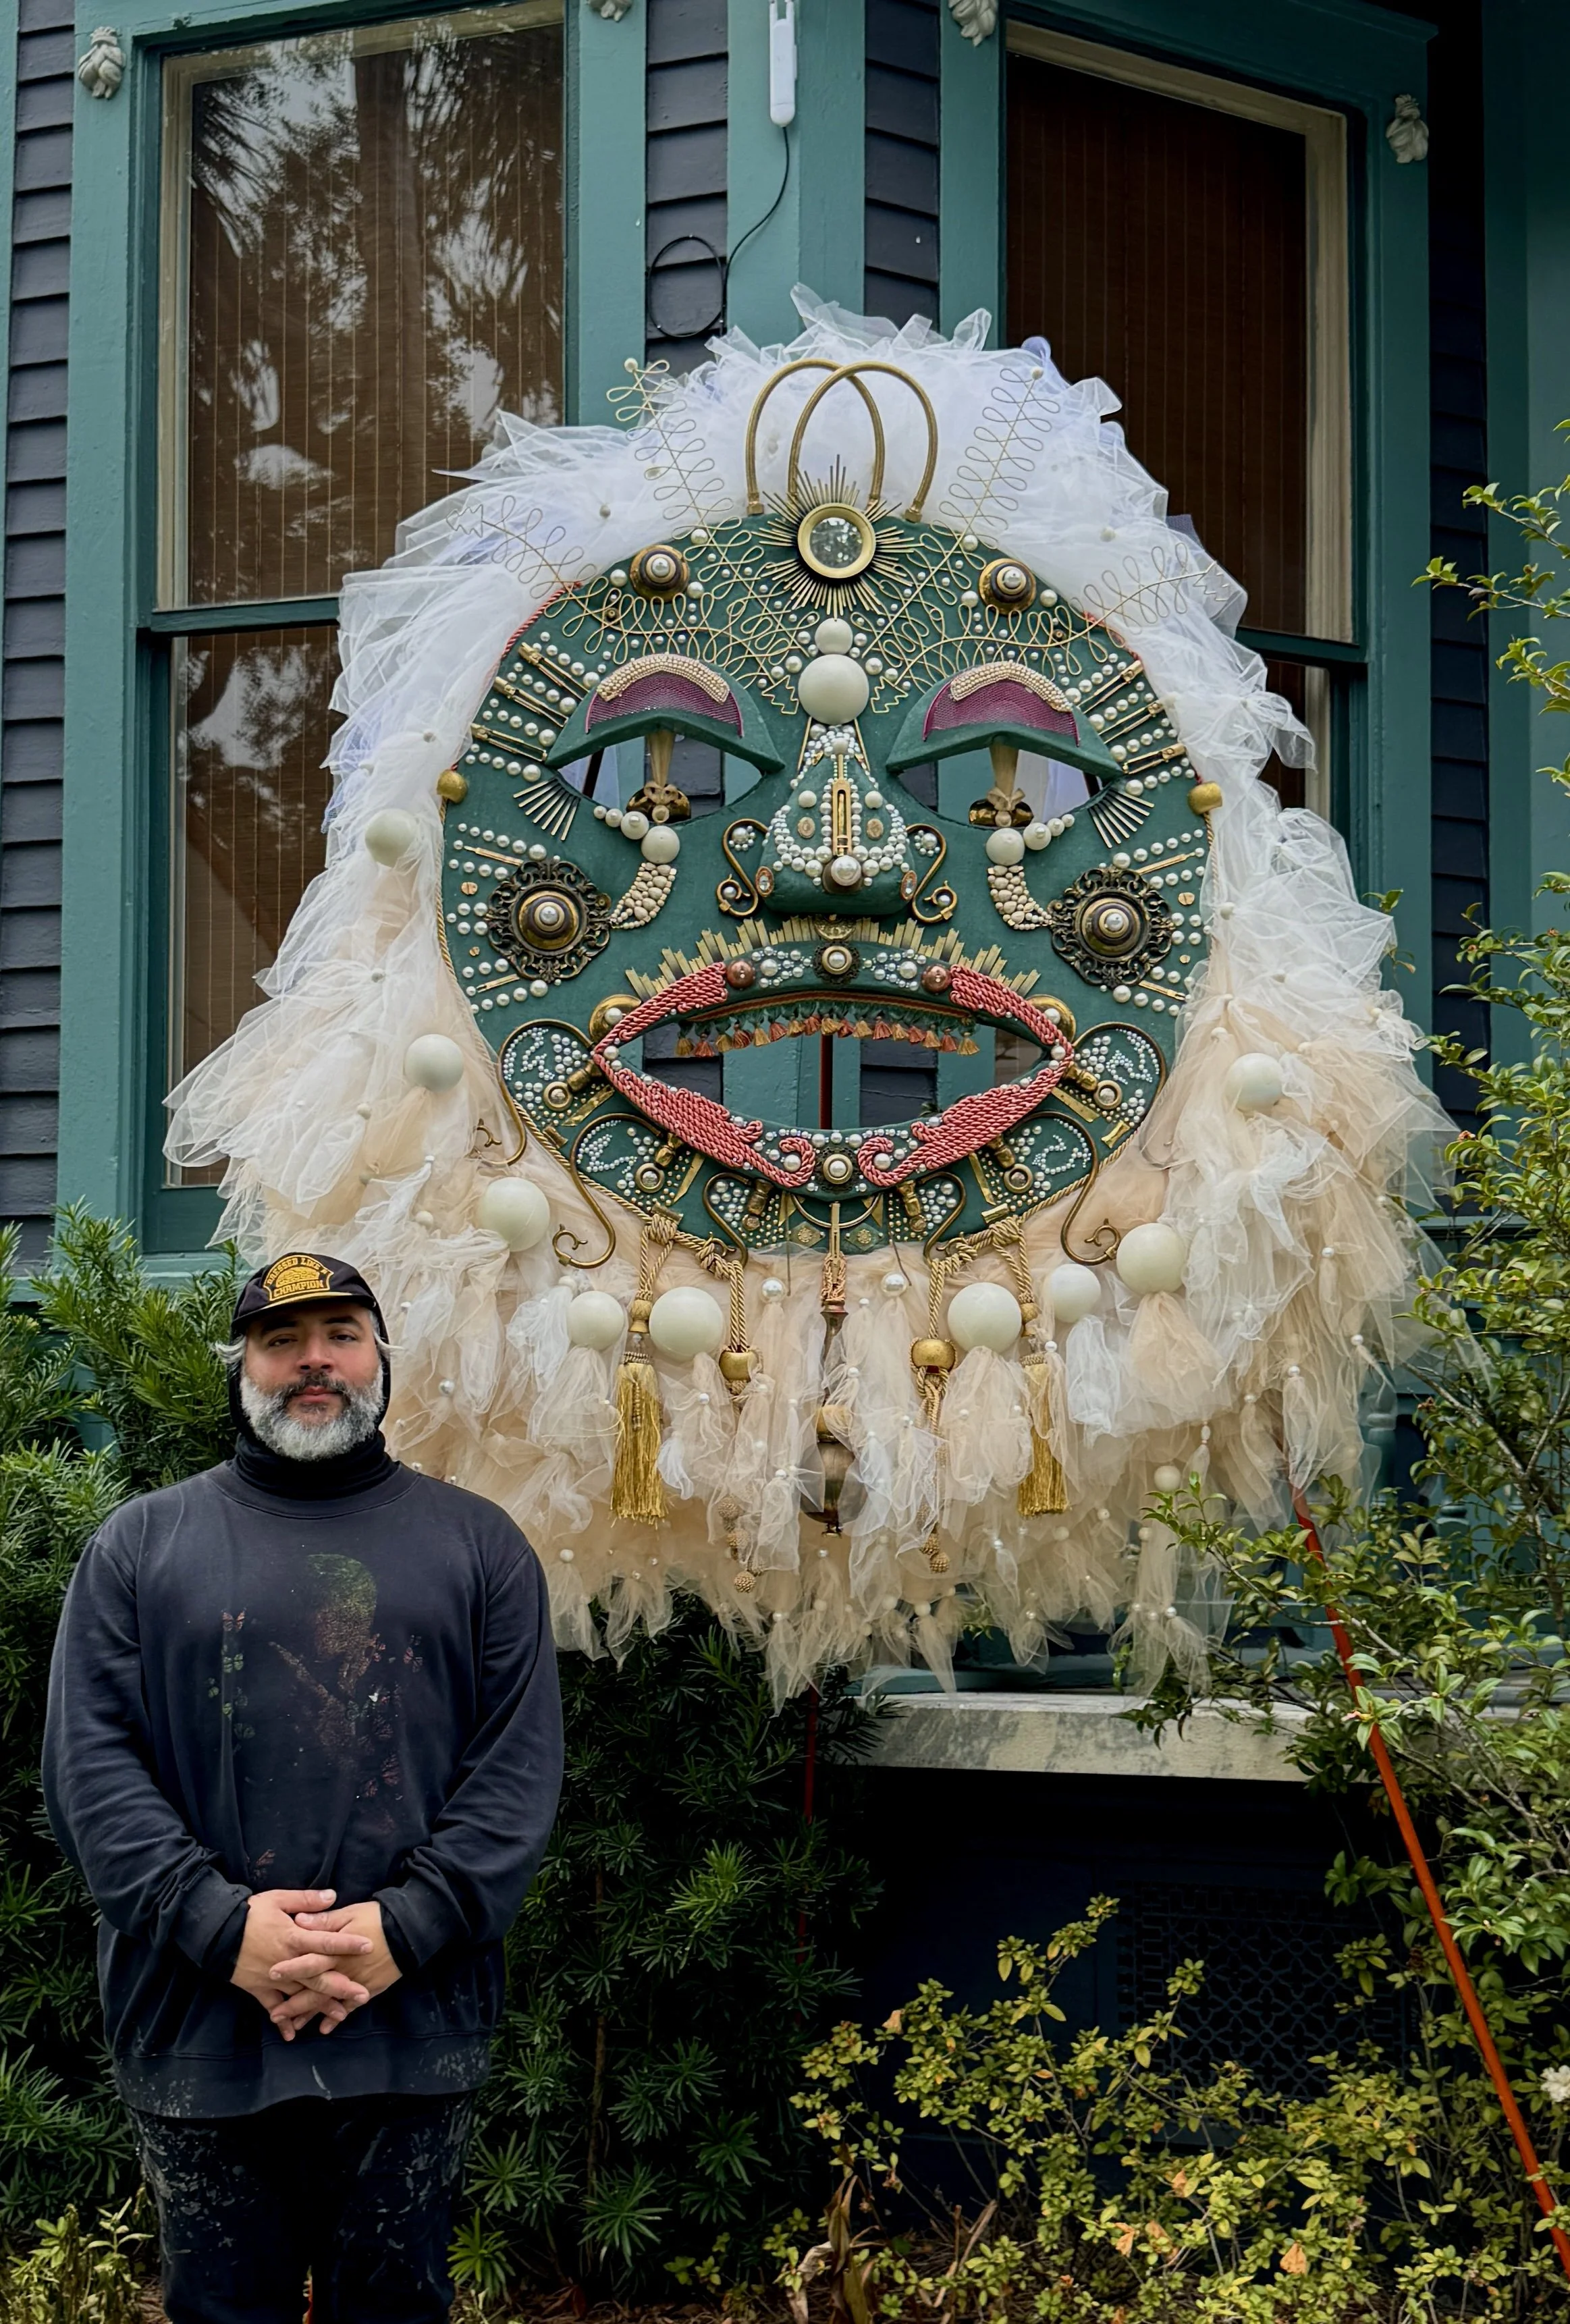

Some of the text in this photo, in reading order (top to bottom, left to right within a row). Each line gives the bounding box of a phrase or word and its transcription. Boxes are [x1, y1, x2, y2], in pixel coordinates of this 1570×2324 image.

[267, 1258, 298, 1285] DRESSED
[300, 1258, 321, 1270] LIKE
[273, 1280, 324, 1297] CHAMPION
